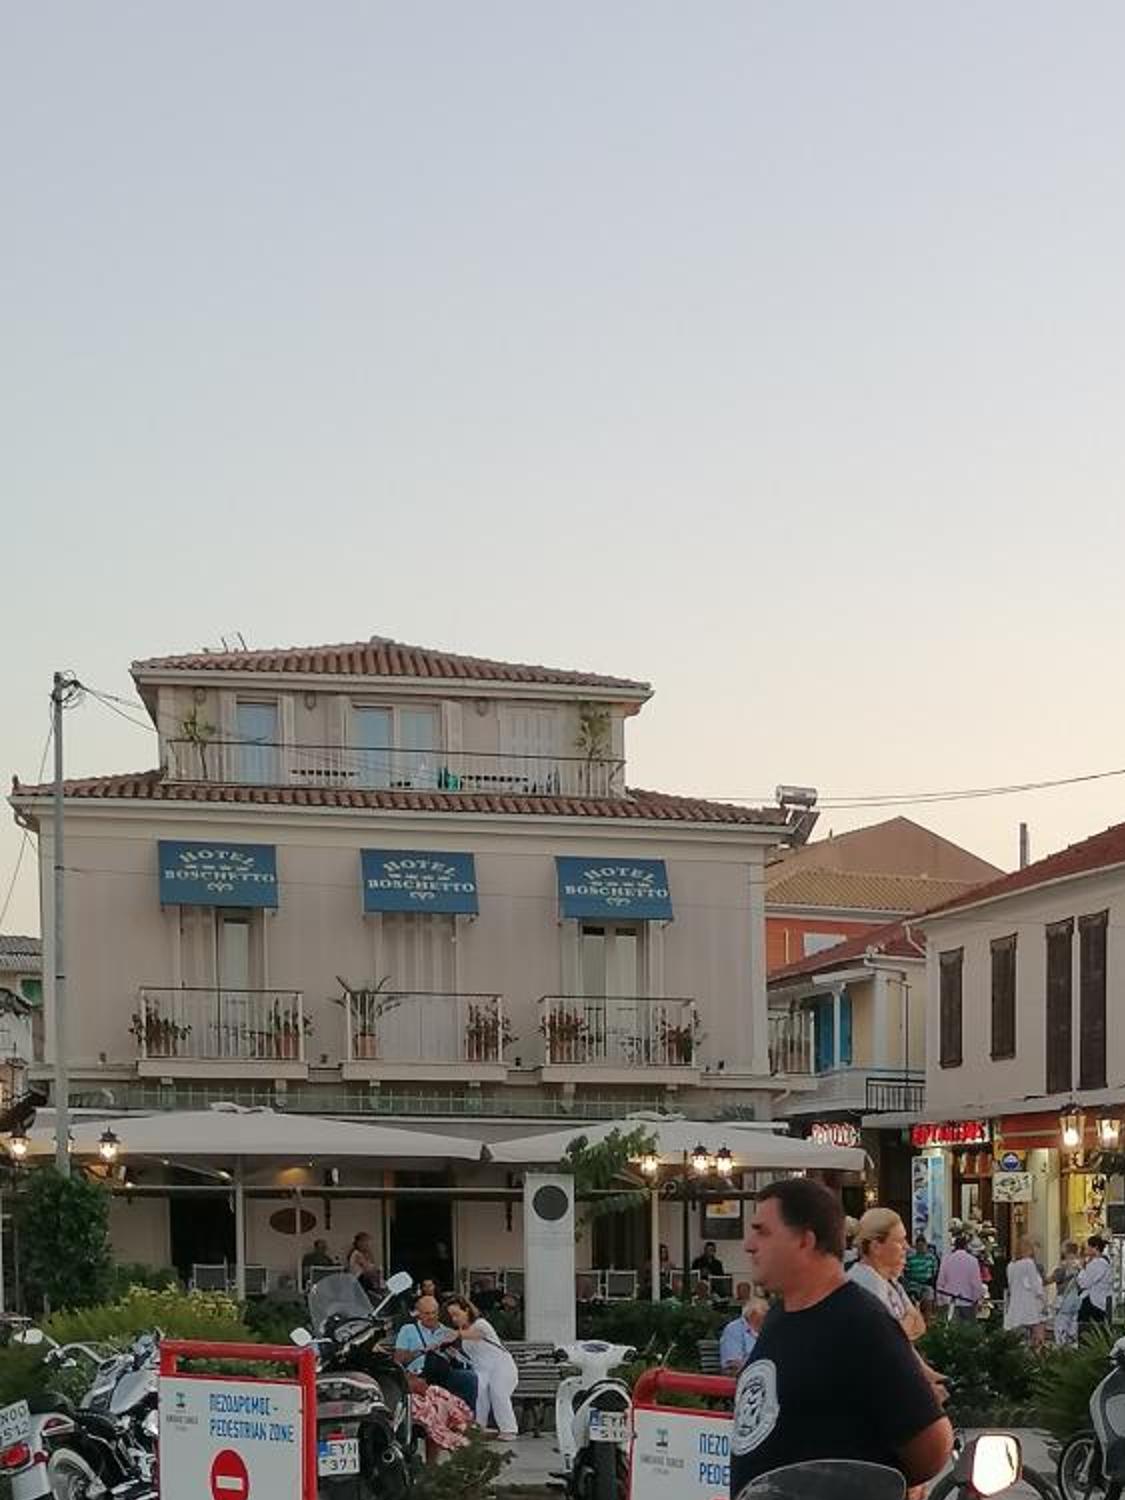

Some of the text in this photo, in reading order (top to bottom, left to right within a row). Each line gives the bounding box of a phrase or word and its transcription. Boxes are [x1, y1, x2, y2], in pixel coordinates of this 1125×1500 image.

[179, 849, 255, 868] HOTEL
[164, 869, 275, 882] BOSCHETTO
[383, 859, 456, 877] HOTEL
[583, 867, 655, 884] HOTEL
[367, 879, 474, 893] BOSCHETTO
[563, 885, 668, 898] BOSCHETTO
[210, 1418, 266, 1440] PEDESTRIAN
[269, 1423, 294, 1442] ZONE
